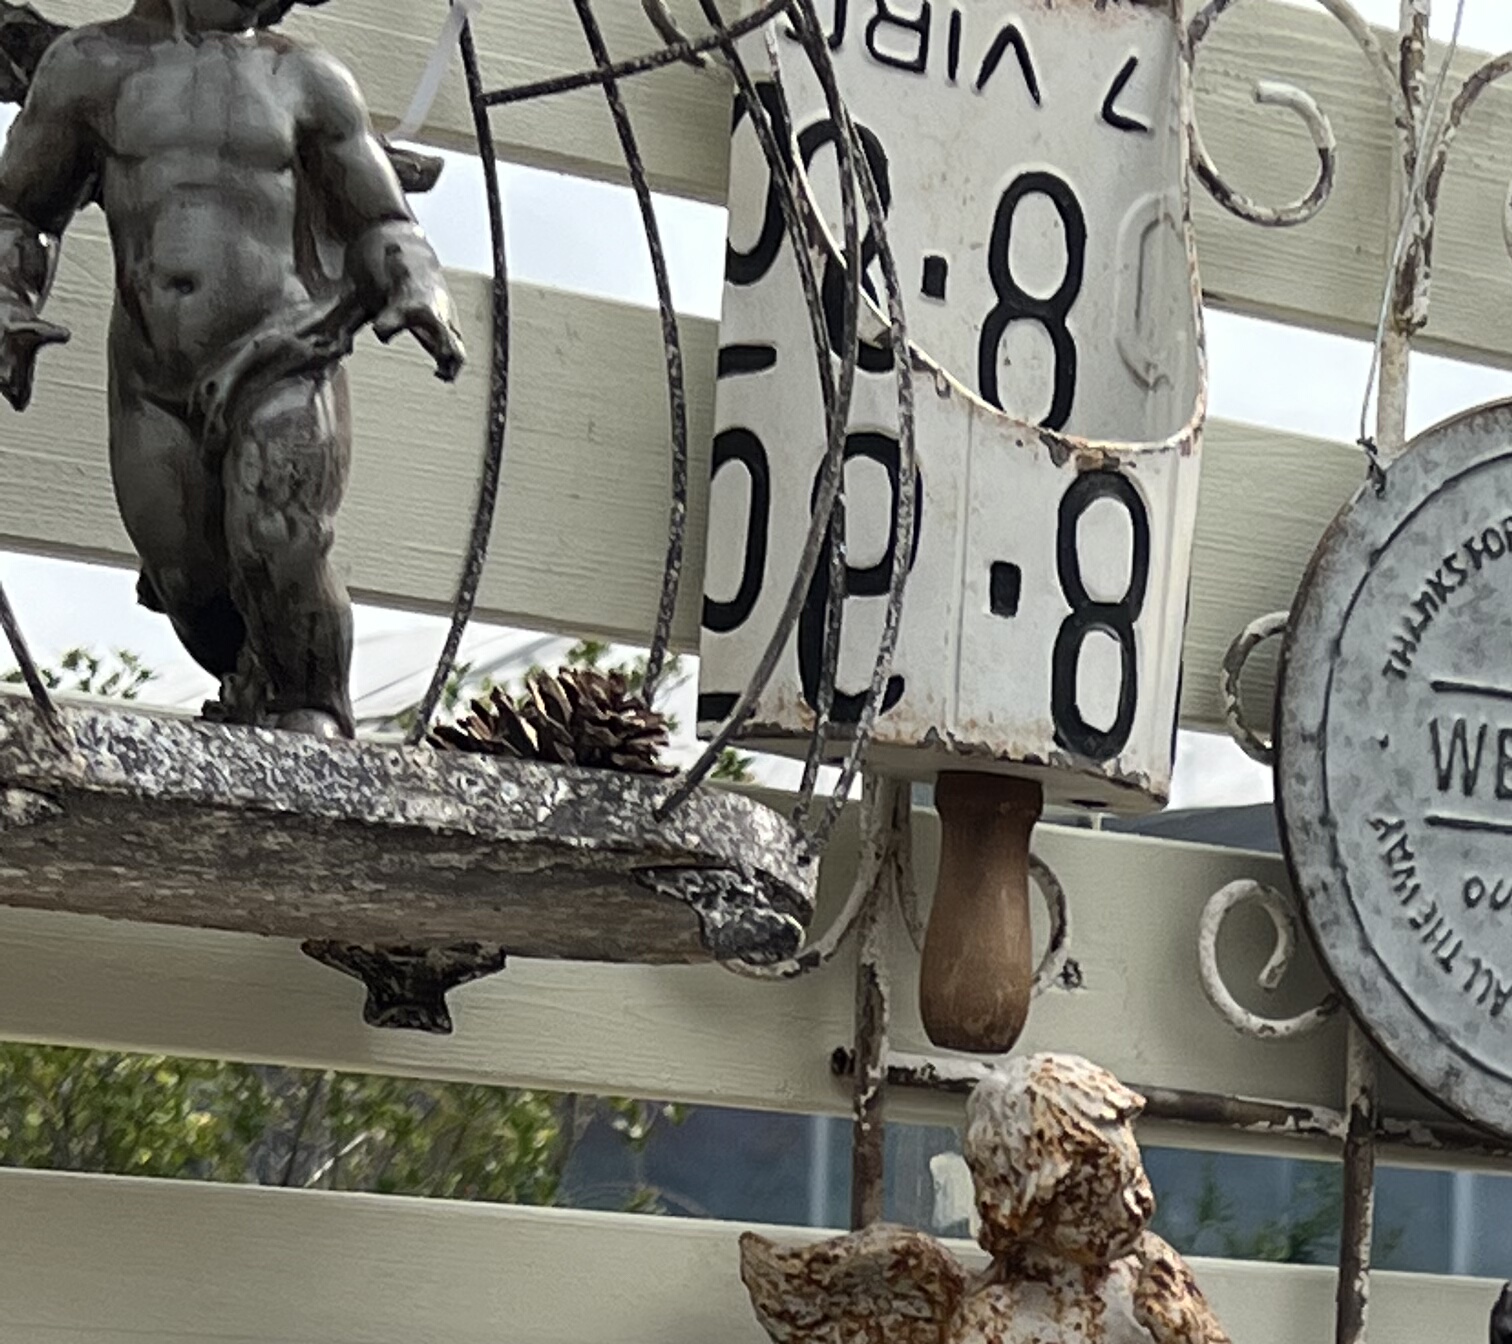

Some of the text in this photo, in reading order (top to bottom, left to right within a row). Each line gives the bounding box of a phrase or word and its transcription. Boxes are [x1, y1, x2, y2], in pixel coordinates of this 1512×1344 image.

[1381, 552, 1469, 681] THANKS
[1364, 817, 1422, 906] WAY
[1408, 901, 1463, 974] THE
